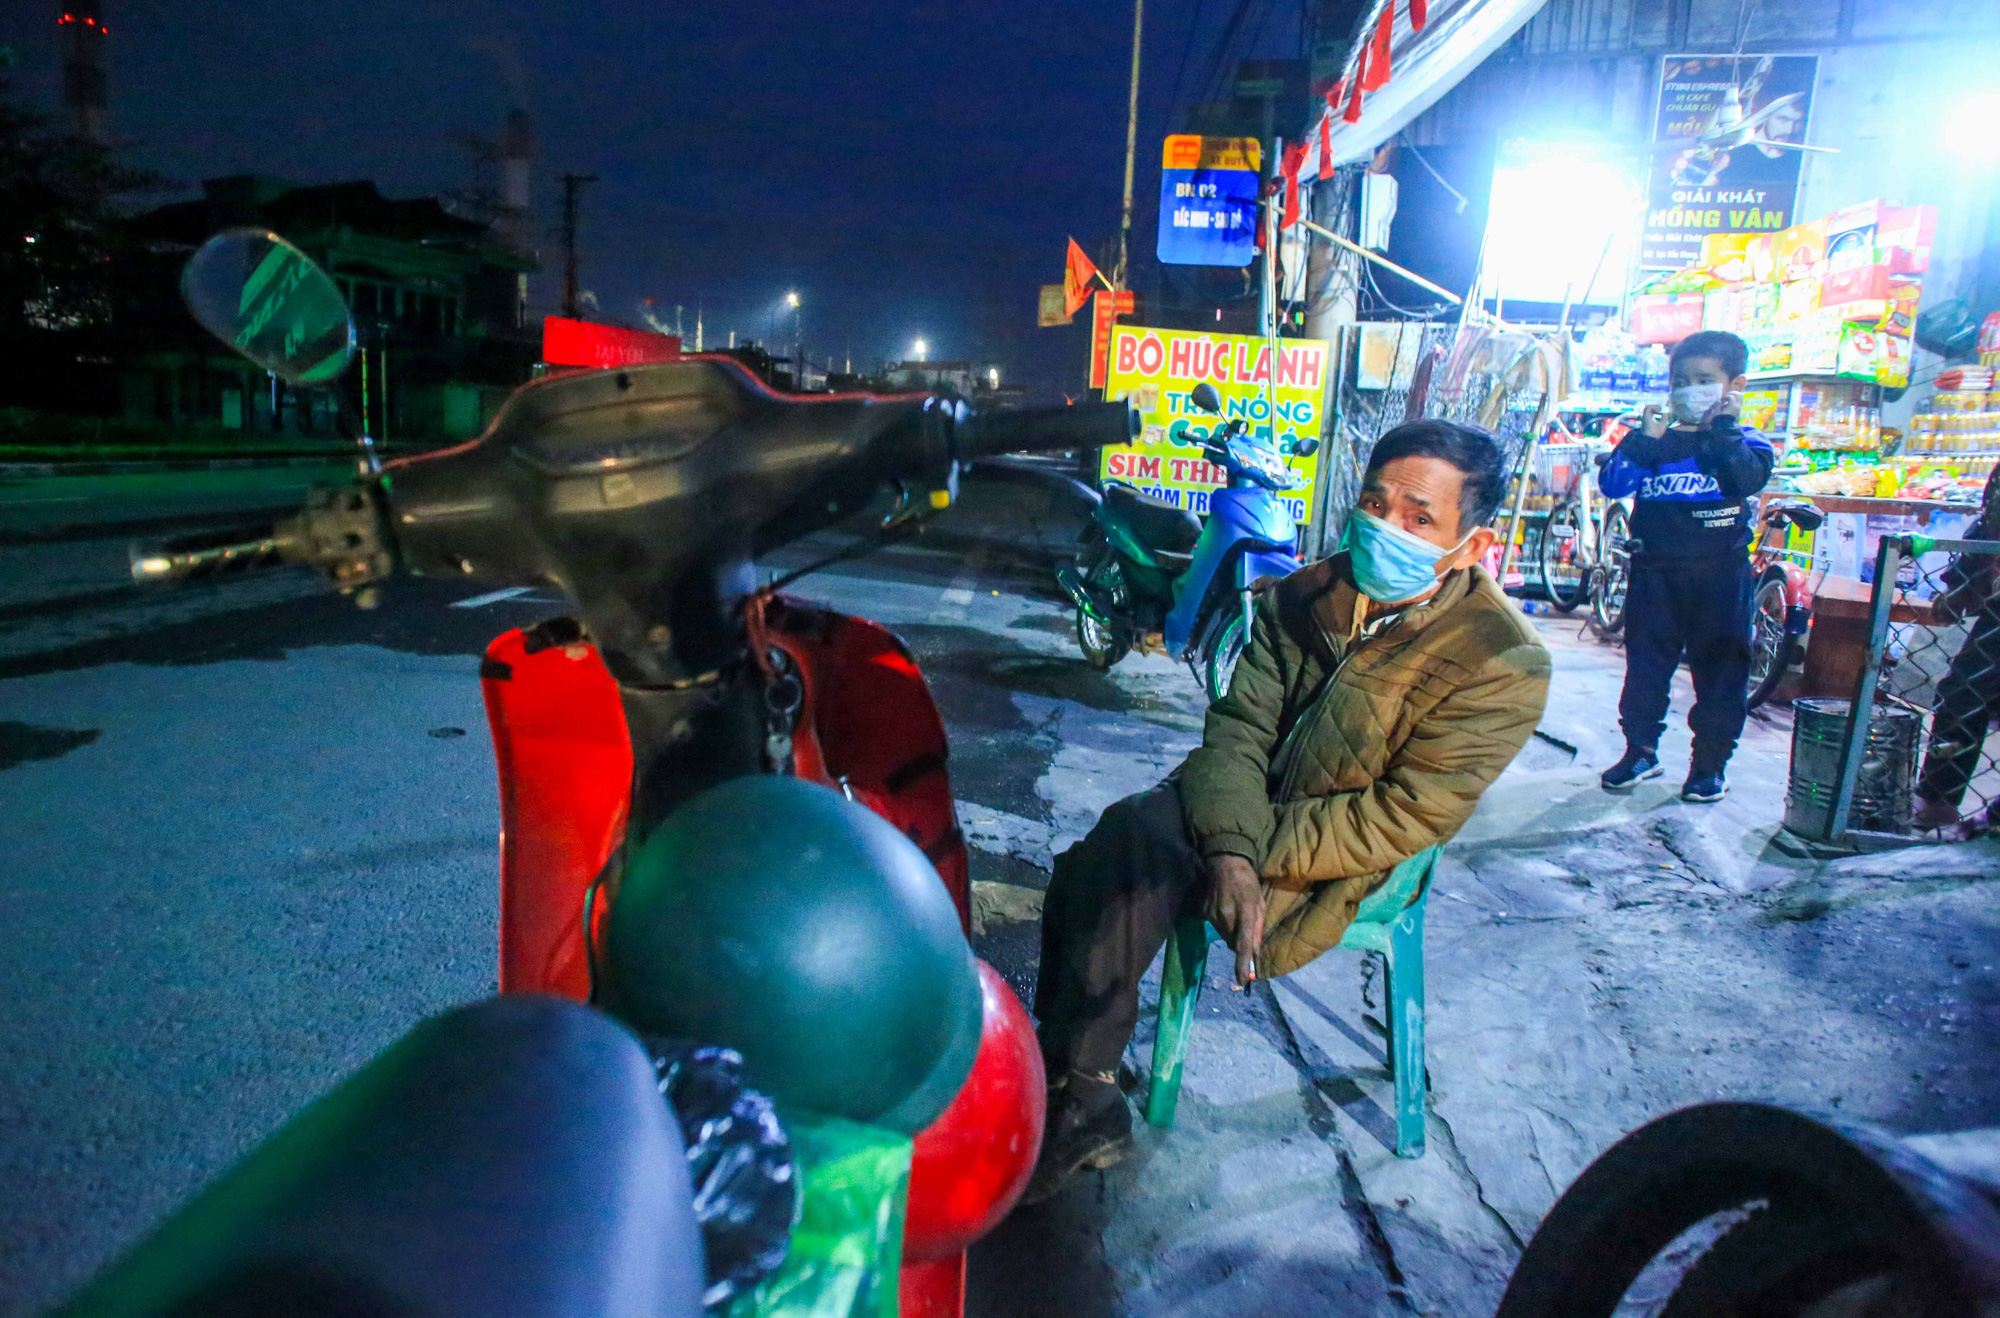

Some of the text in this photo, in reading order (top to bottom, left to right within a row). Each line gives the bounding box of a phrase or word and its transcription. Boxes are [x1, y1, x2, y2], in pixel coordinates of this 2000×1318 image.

[1175, 182, 1217, 198] BN 02
[1729, 207, 1784, 229] VÂN
[1117, 332, 1321, 390] BÒ HÚC LẠNH
[1228, 392, 1313, 423] NÓNG
[1108, 454, 1161, 479] SIM
